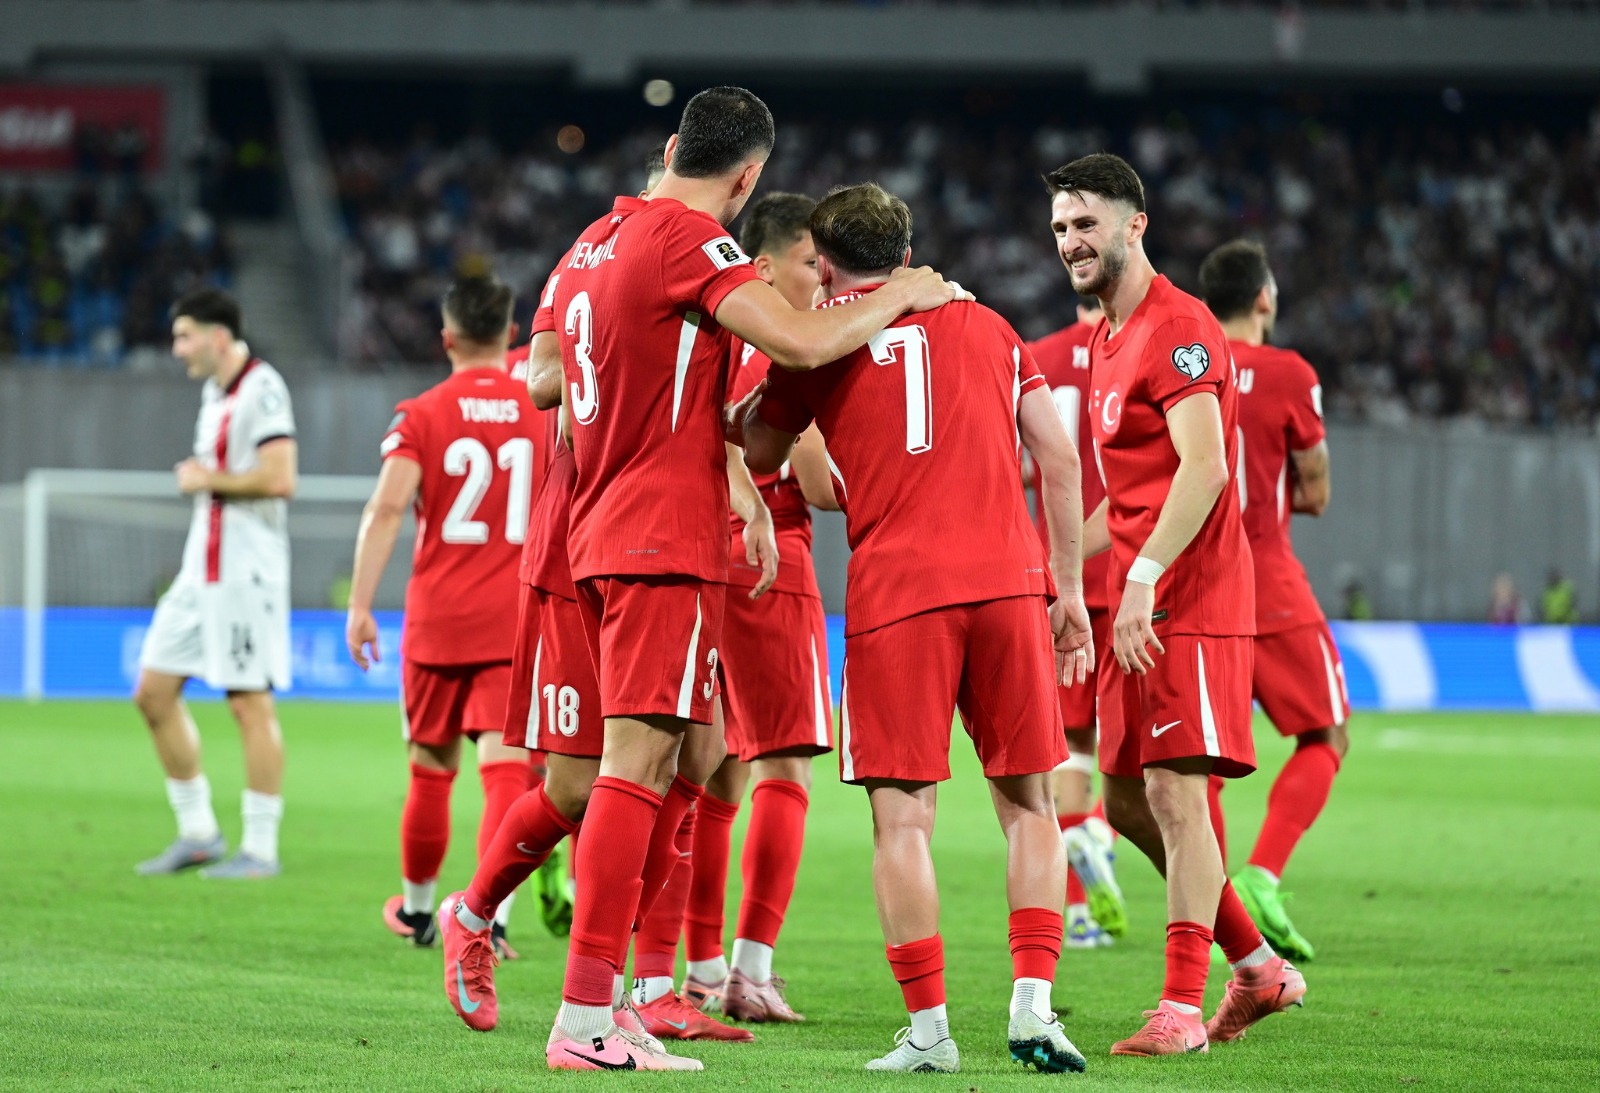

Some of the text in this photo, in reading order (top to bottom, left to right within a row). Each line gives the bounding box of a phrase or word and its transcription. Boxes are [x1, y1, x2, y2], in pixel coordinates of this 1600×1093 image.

[565, 290, 600, 425] 3
[867, 324, 932, 455] 7
[458, 397, 520, 423] YUNUS
[441, 437, 534, 545] 21
[542, 684, 580, 737] 18
[703, 647, 718, 700] 3
